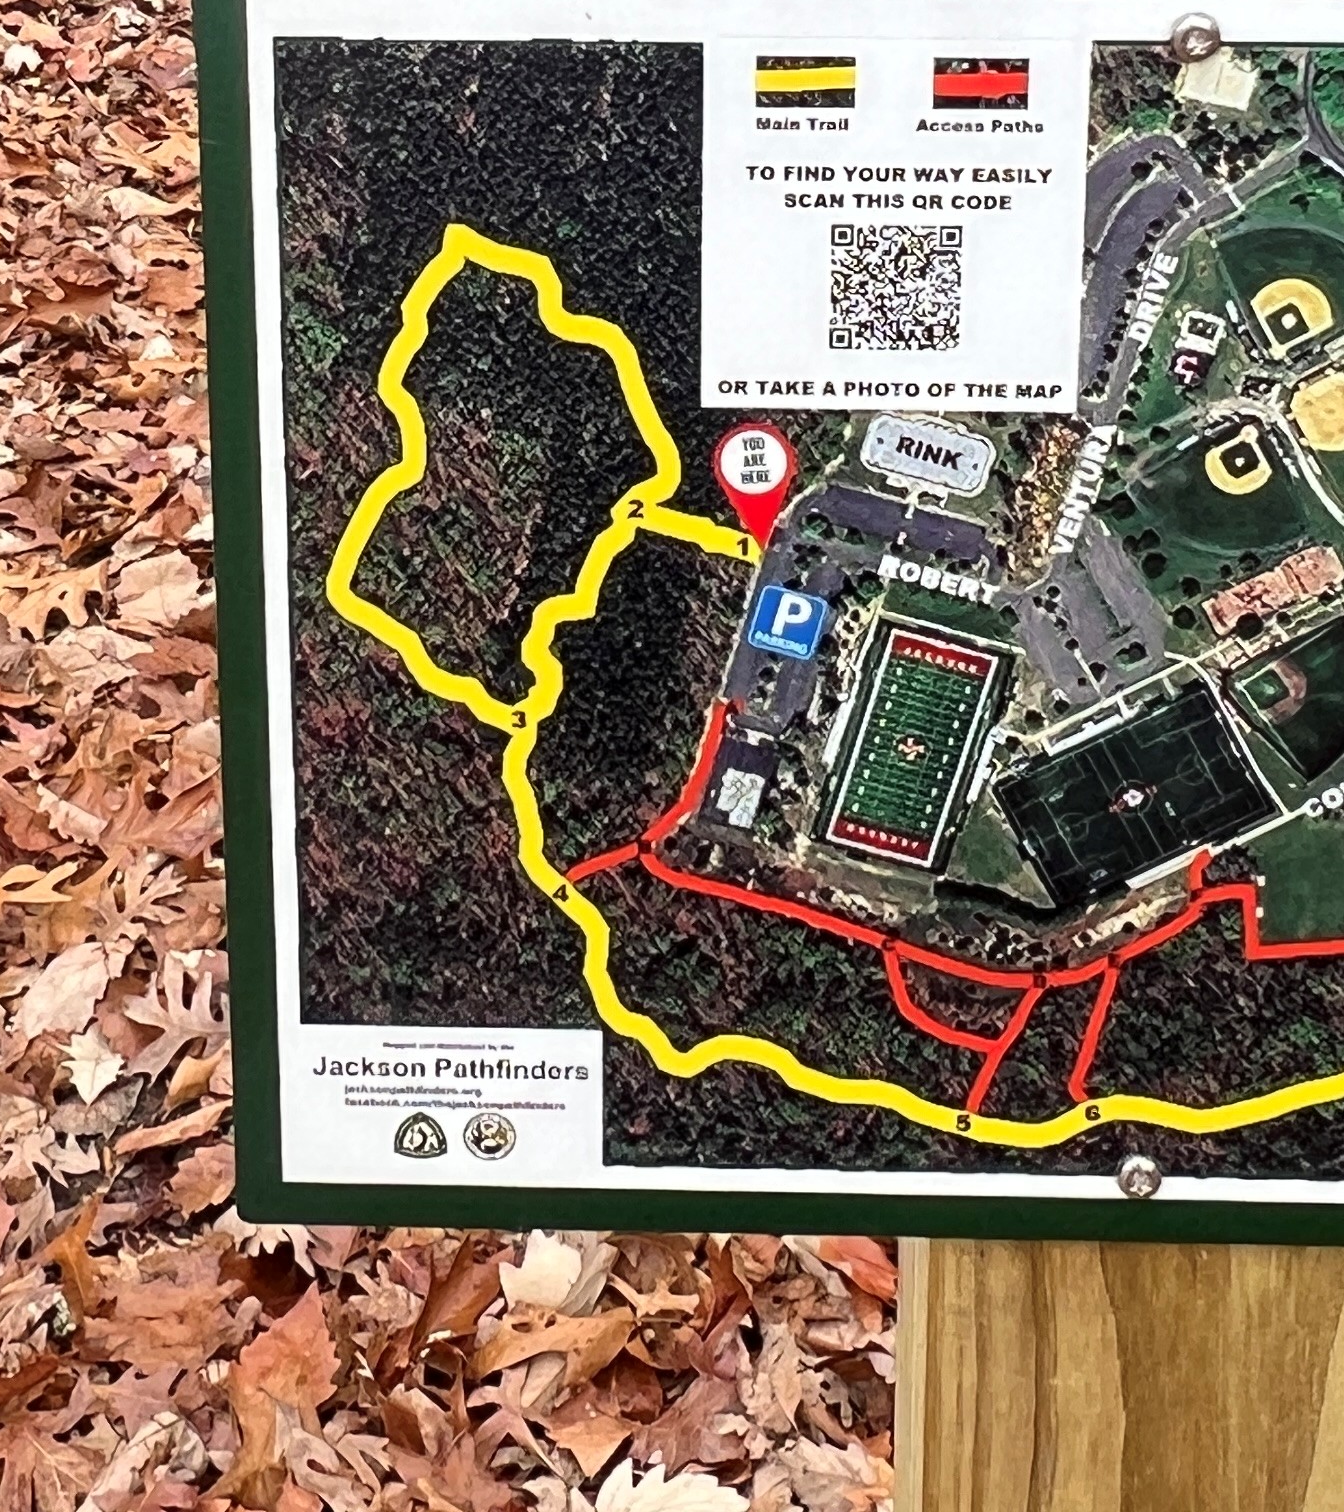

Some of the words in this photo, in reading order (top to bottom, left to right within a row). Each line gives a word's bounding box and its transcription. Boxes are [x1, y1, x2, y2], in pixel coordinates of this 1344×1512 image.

[756, 117, 801, 131] Main
[806, 118, 849, 131] Trail
[915, 118, 985, 133] Access
[991, 119, 1044, 134] Paths
[745, 165, 775, 181] TO
[784, 165, 836, 182] FIND
[843, 166, 906, 182] YOUR
[913, 167, 965, 183] WAY
[972, 168, 1053, 184] EASILY
[784, 193, 845, 208] SCAN
[852, 193, 904, 209] THIS
[912, 194, 944, 210] QR
[951, 195, 1012, 210] CODE
[1127, 252, 1179, 352] DRIVE
[718, 380, 748, 395] OR
[755, 380, 815, 396] TAKE
[822, 381, 837, 396] A
[844, 381, 920, 398] PHOTO
[927, 383, 956, 398] OF
[963, 383, 1008, 399] THE
[1015, 384, 1062, 399] MAP
[896, 436, 966, 471] RINK
[1049, 425, 1118, 554] VENTURA
[628, 500, 644, 519] 2
[737, 538, 750, 557] 1
[877, 554, 1001, 605] ROBERT
[771, 592, 813, 636] P
[512, 710, 527, 728] 3
[553, 884, 569, 902] 4
[312, 1055, 426, 1078] Jackson
[435, 1058, 590, 1081] Pathfinders
[1085, 1105, 1101, 1121] 6
[956, 1114, 971, 1132] 5
